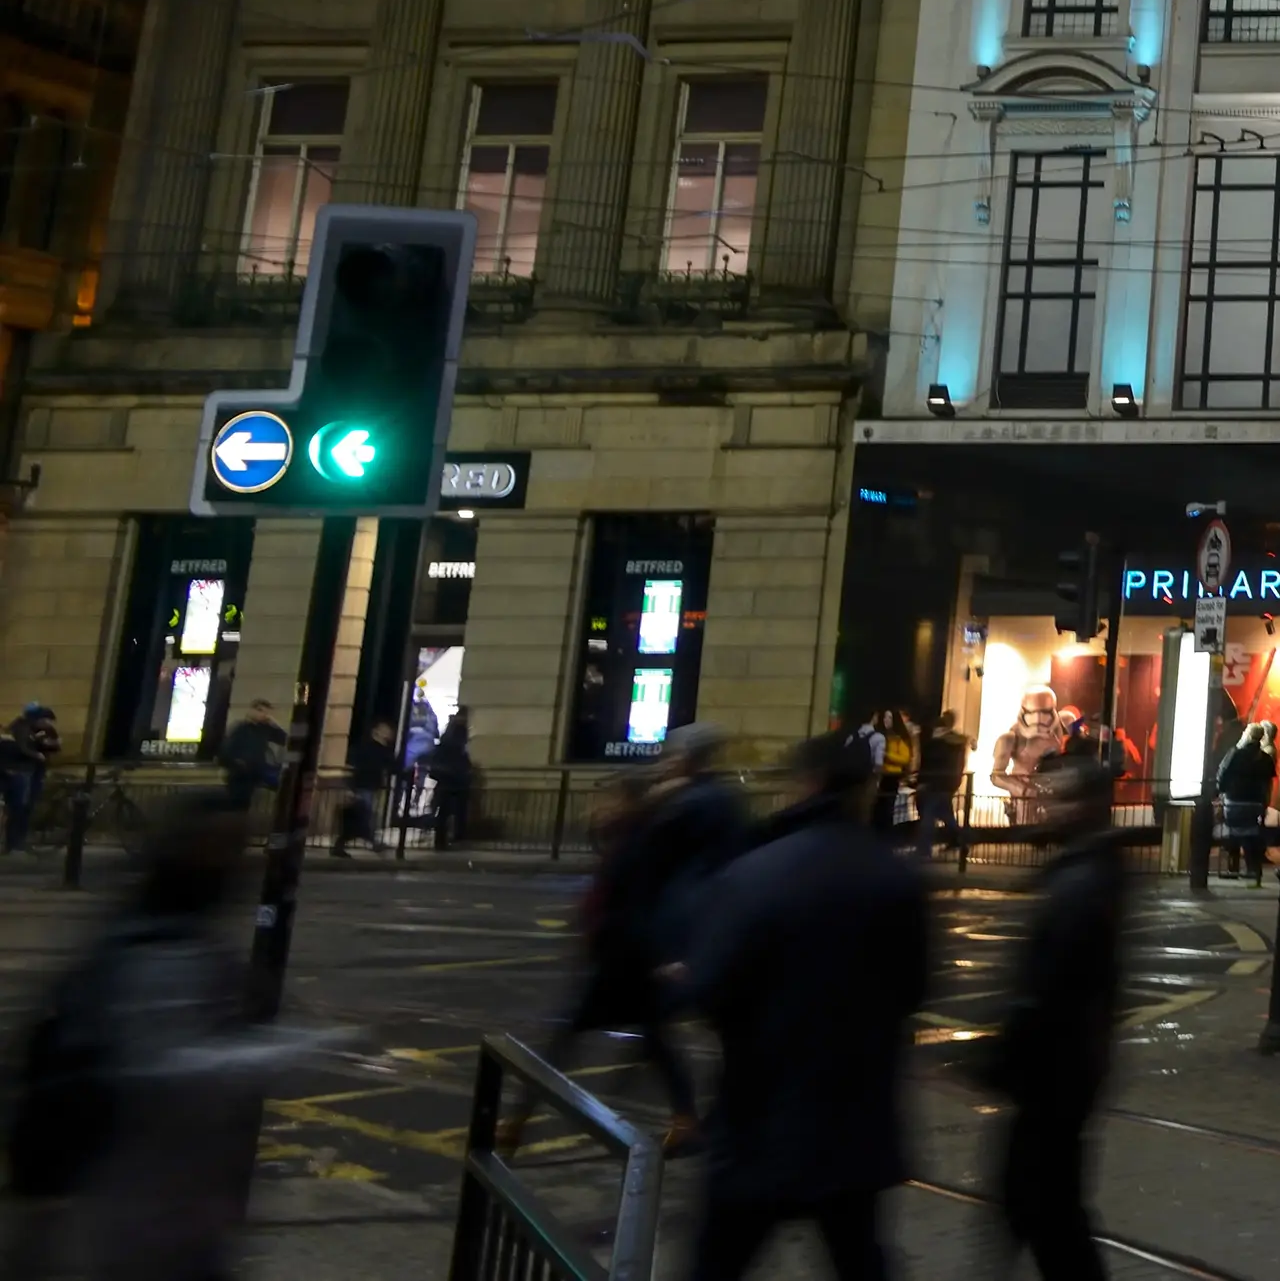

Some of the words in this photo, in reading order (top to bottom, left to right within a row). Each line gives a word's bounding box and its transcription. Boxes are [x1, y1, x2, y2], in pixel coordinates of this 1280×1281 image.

[170, 559, 227, 574] BETFRED
[625, 560, 684, 574] BETFRED
[604, 741, 663, 756] BETFRED
